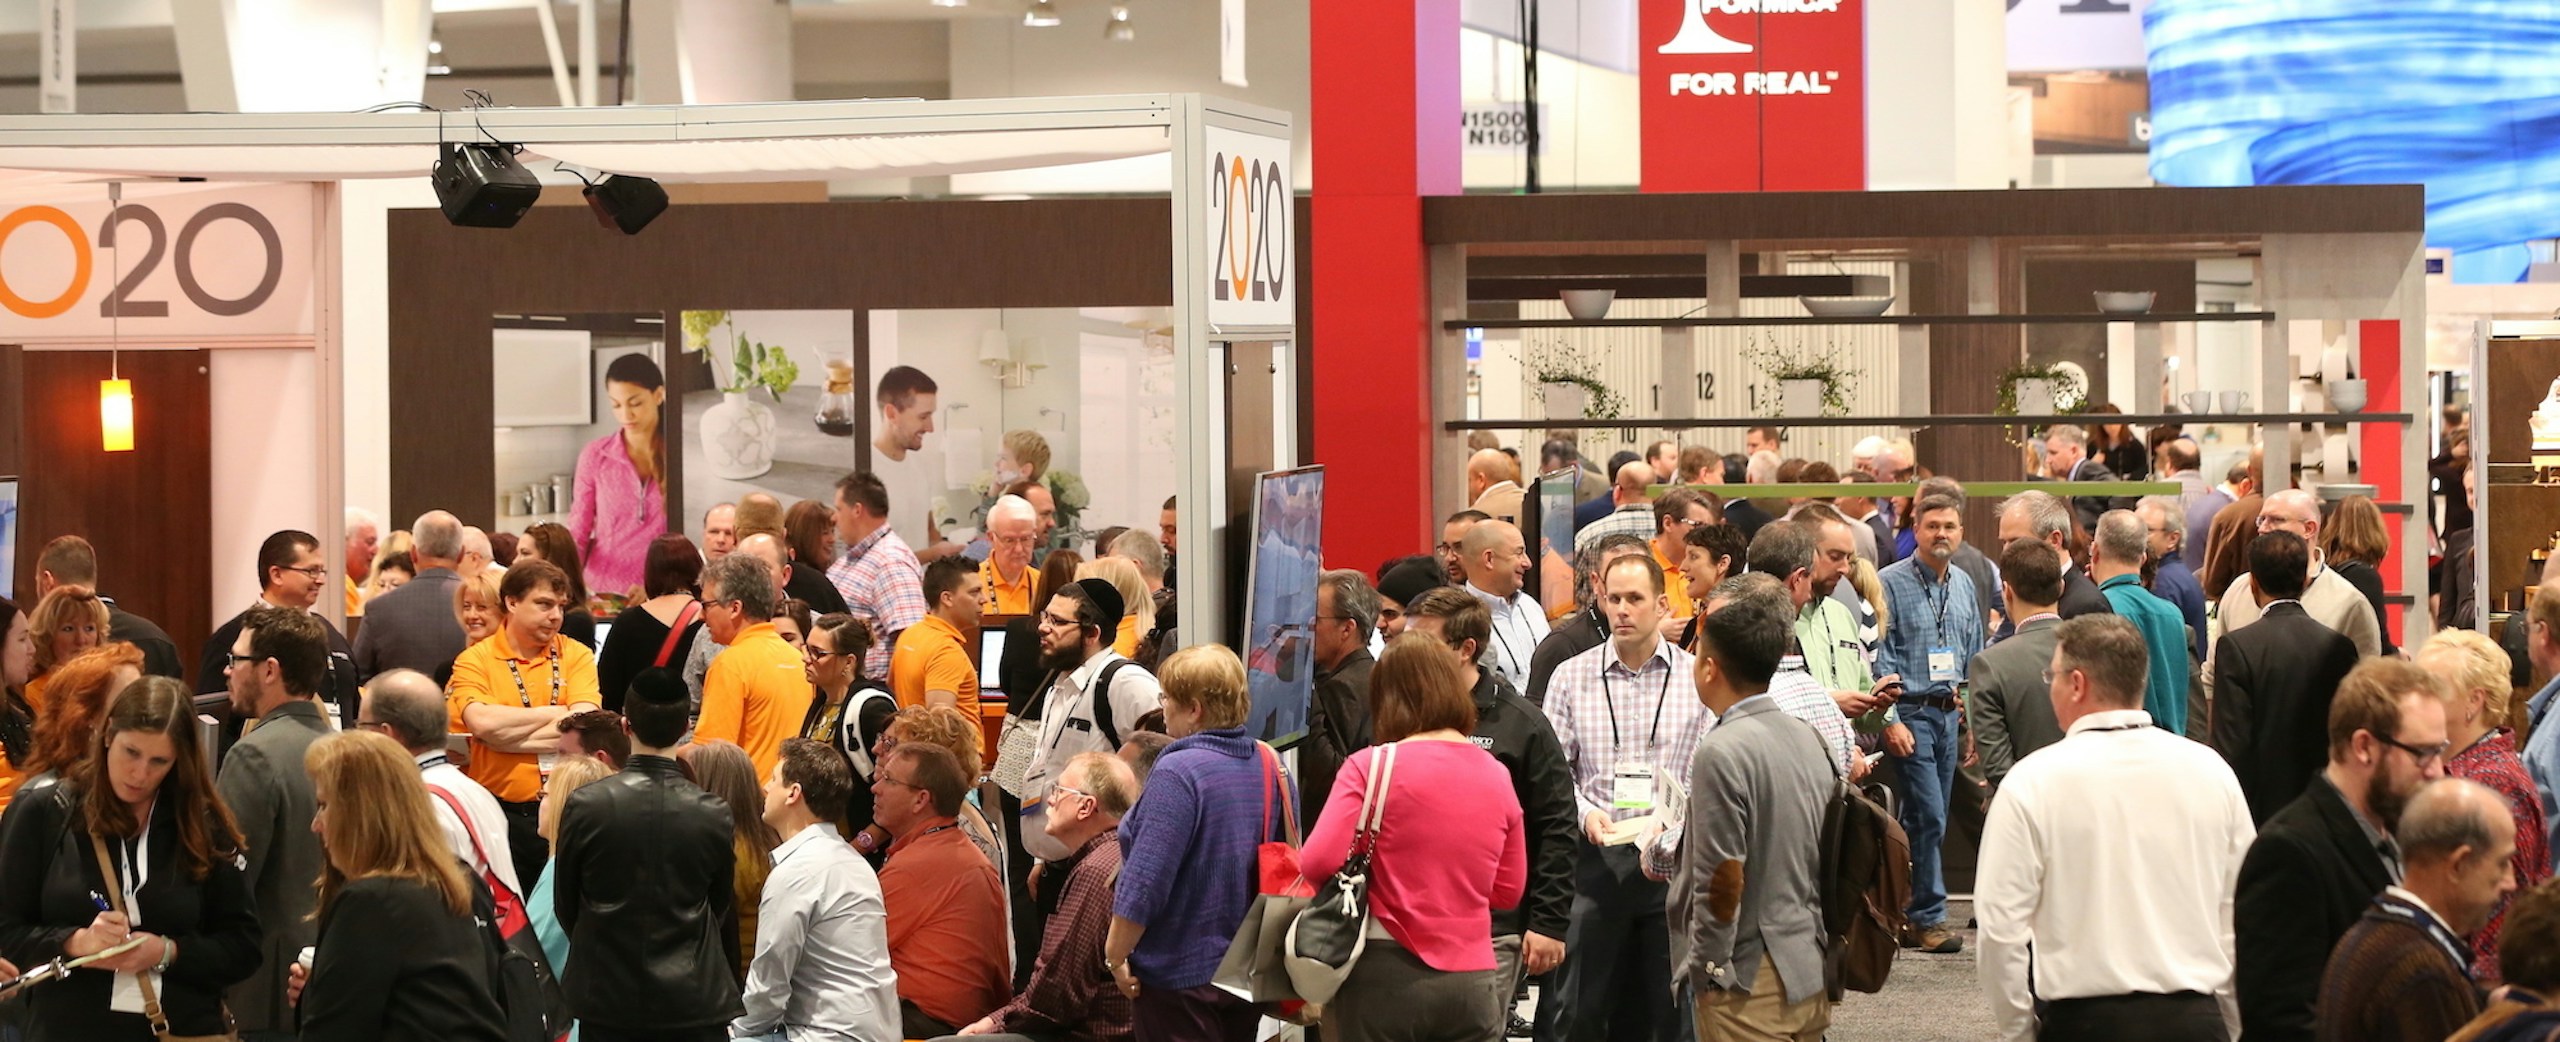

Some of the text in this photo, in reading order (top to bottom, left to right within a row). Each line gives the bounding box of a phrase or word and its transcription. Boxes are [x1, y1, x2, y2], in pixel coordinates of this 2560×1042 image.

[1669, 72, 1736, 96] FOR
[1469, 129, 1539, 145] N160
[1213, 152, 1285, 302] 2020
[1696, 372, 1714, 400] 12
